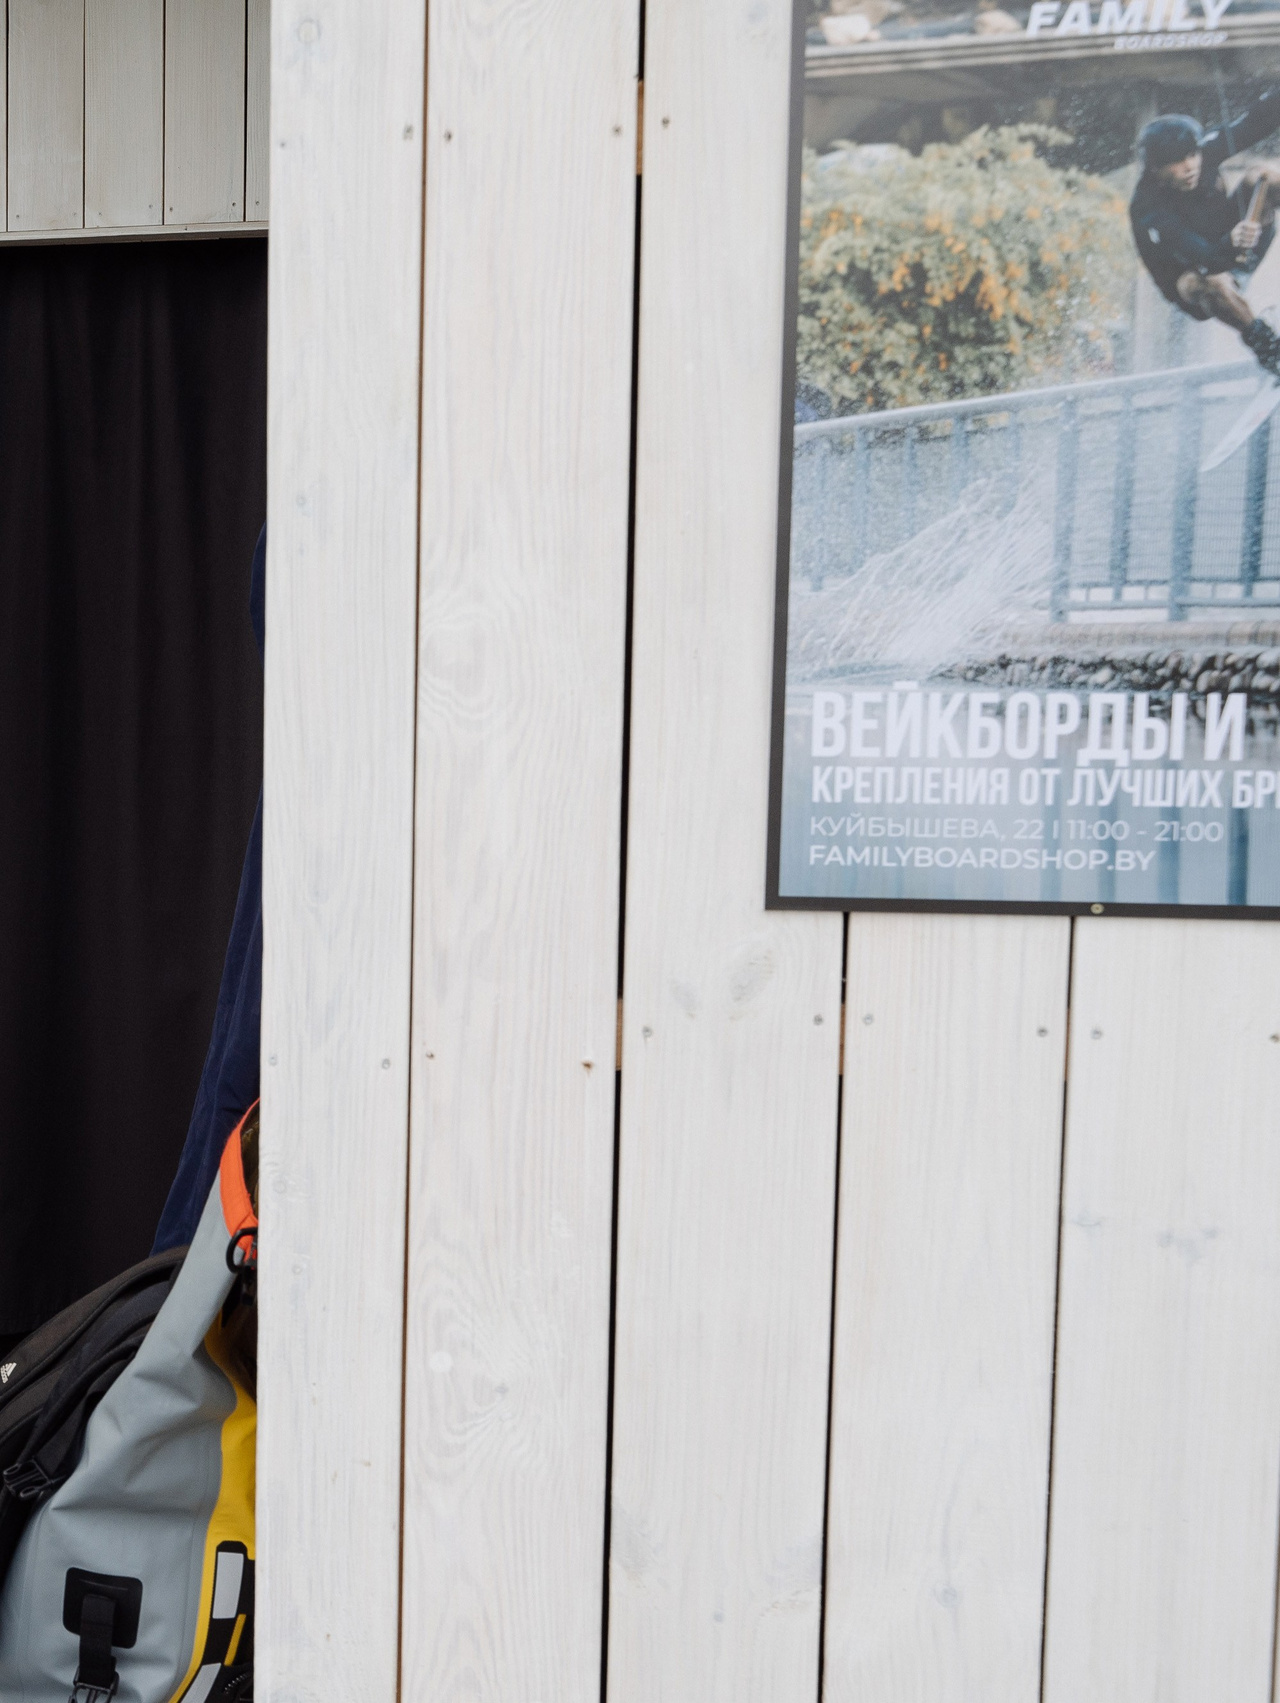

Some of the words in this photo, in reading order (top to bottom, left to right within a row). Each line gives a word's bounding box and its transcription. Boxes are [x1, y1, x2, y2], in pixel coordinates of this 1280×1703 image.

[1025, 0, 1231, 38] FAMILY
[1113, 32, 1228, 50] BOARDSHOP
[810, 680, 1188, 767] ВЕЙКБОРДЫ
[1204, 692, 1248, 761] И
[811, 766, 1010, 805] КРЕПЛЕНИЯ
[1020, 767, 1061, 805] ОТ
[1067, 768, 1224, 808] ЛУЧШИХ
[809, 812, 1007, 841] КУЙБЫШЕВА,
[1013, 819, 1045, 840] 22
[1067, 819, 1130, 841] 11:00
[1153, 820, 1224, 842] 21:00
[809, 845, 1156, 871] FAMILYBOARDSHOP.BY
